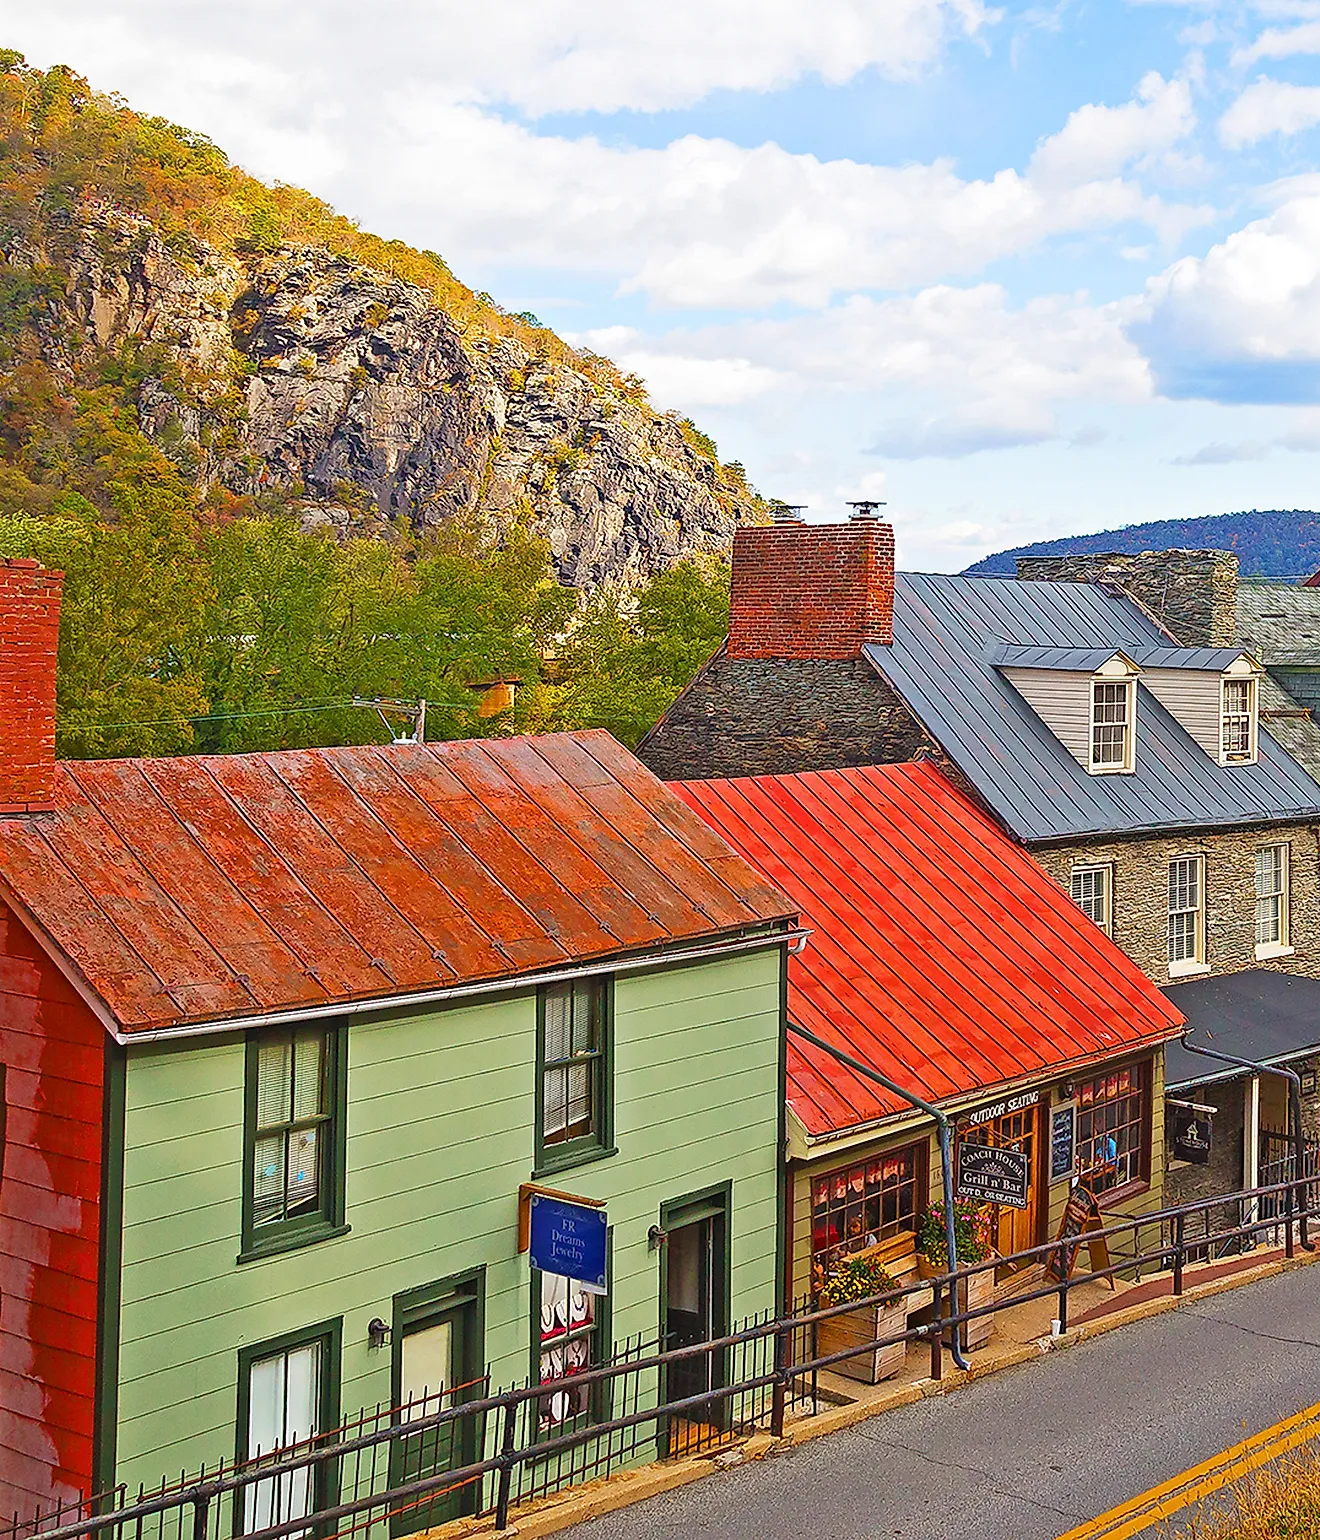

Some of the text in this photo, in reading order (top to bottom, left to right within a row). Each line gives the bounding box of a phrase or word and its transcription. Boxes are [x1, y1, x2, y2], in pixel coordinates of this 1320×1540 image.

[970, 1090, 1038, 1126] OUTDOOR SEATING
[961, 1150, 1024, 1178] COACH HOUSE
[964, 1172, 1022, 1192] Grill n' Bar
[562, 1219, 576, 1232] FR
[552, 1229, 586, 1247] Dreams
[550, 1242, 584, 1264] Jewelry
